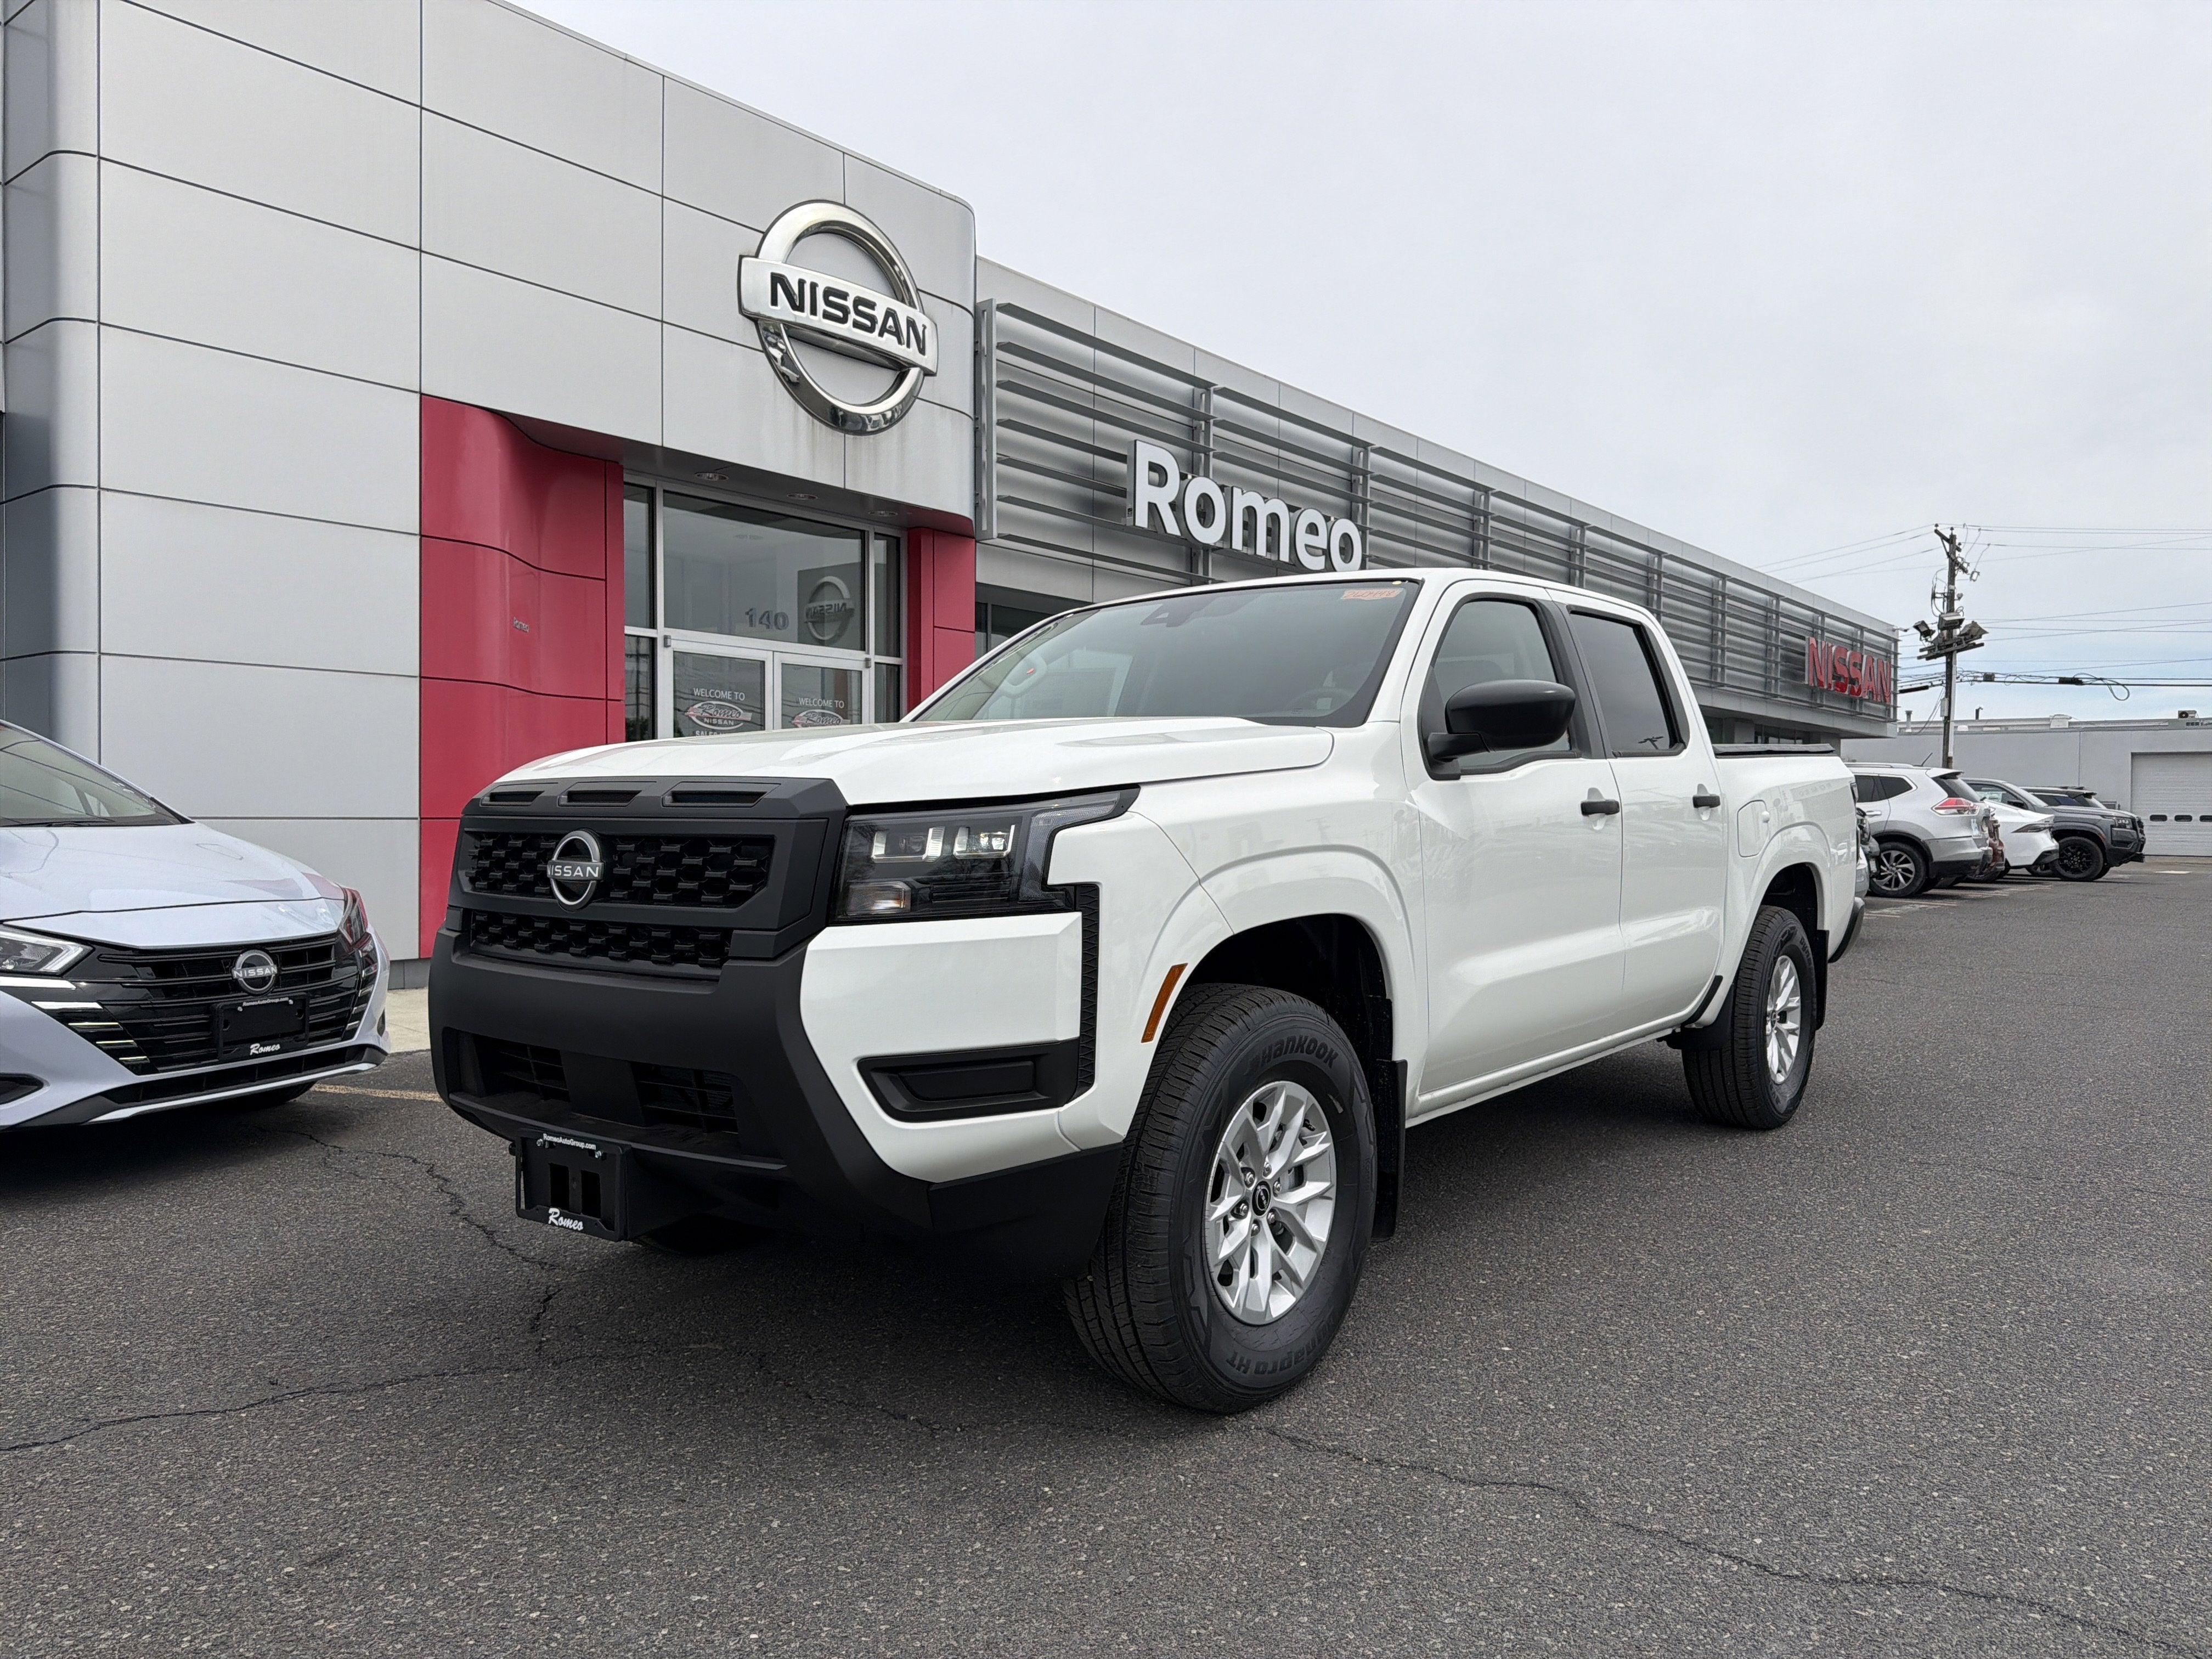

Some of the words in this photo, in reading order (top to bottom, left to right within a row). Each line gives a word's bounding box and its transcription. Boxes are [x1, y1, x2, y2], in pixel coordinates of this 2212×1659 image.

[769, 272, 927, 357] NISSAN
[1132, 439, 1362, 572] Romeo
[745, 607, 789, 630] 140
[1808, 636, 1891, 706] NISSAN
[693, 687, 732, 700] WELCOME
[734, 691, 746, 701] TO
[701, 703, 742, 718] Romeo
[798, 697, 833, 708] WELCOME
[834, 700, 845, 709] TO
[805, 711, 841, 725] Romeo
[547, 865, 599, 878] NISSAN
[234, 967, 278, 978] NISSAN
[250, 1043, 280, 1056] Romeo
[543, 1133, 596, 1150] RomeoAutoGroup.com
[549, 1207, 584, 1231] Romeo
